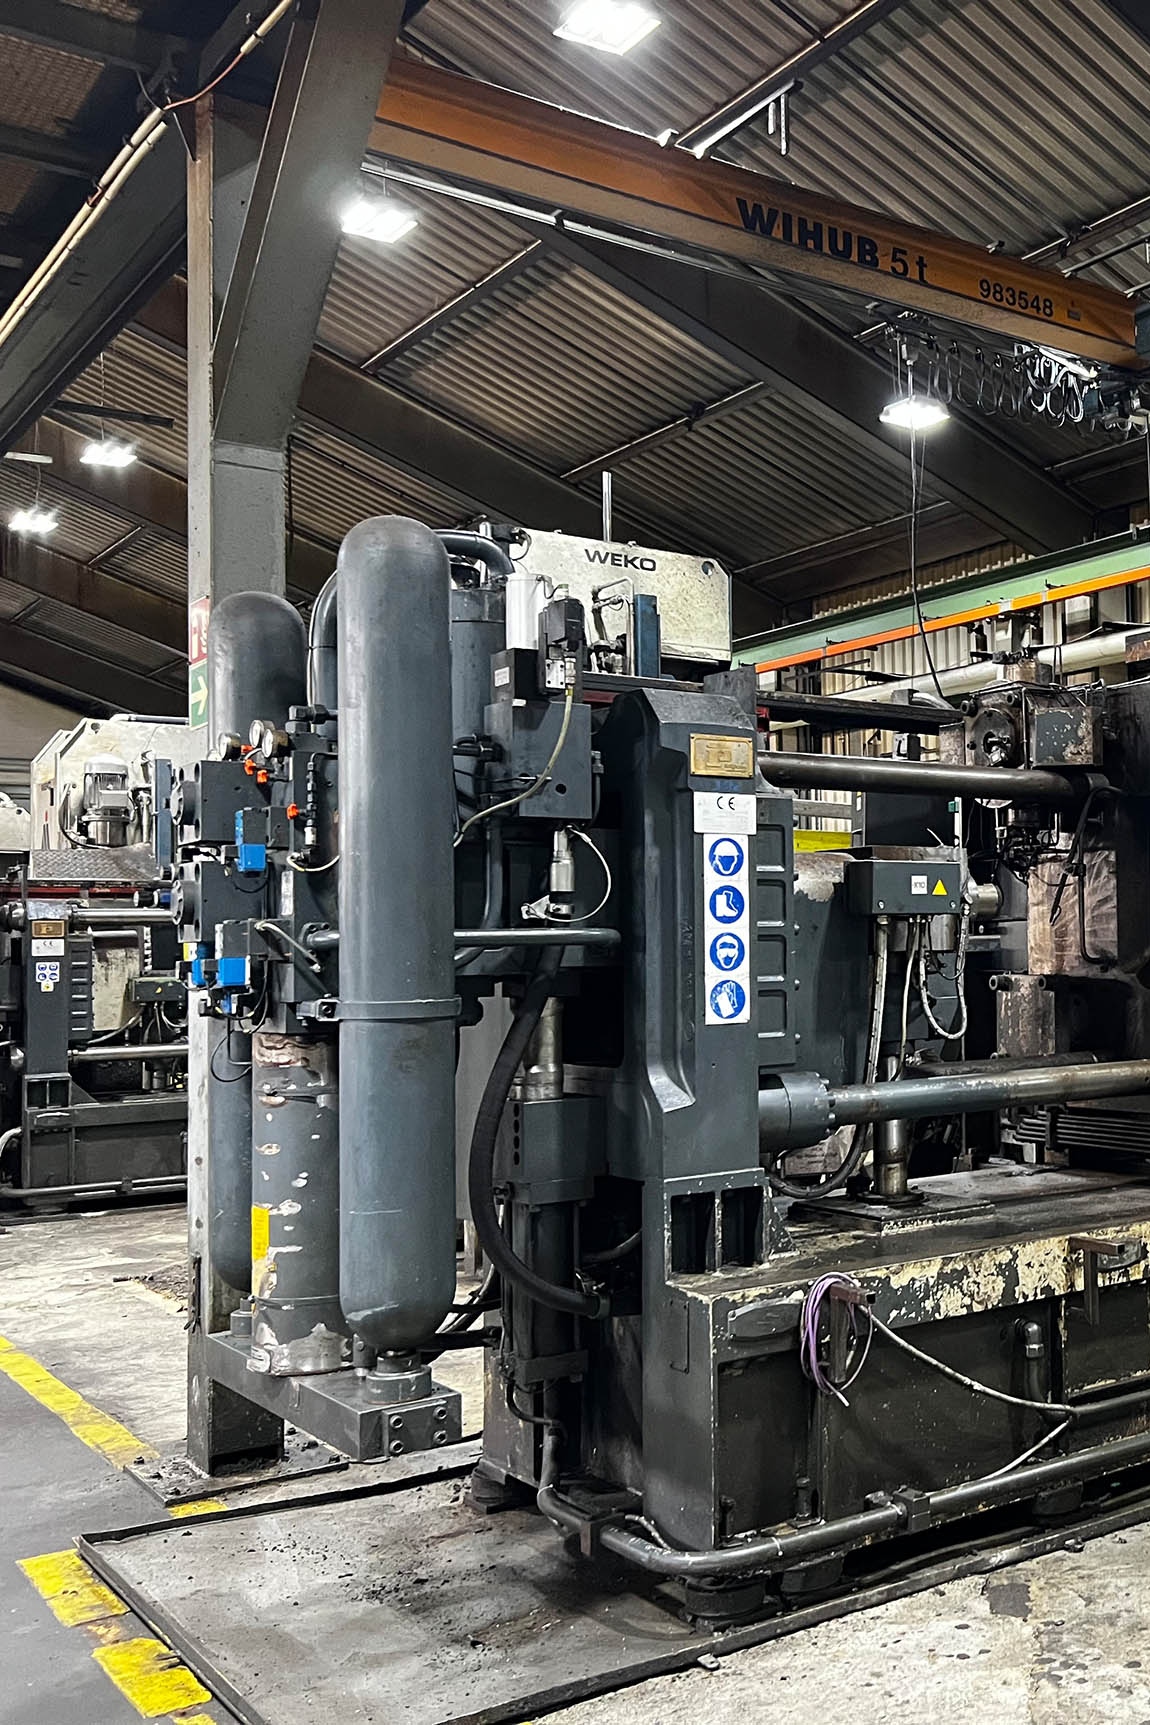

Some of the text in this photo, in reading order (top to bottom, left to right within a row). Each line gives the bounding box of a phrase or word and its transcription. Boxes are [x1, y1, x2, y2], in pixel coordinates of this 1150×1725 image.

[736, 198, 880, 268] WIHUB
[979, 279, 1054, 317] 983548
[584, 548, 657, 572] WEKO
